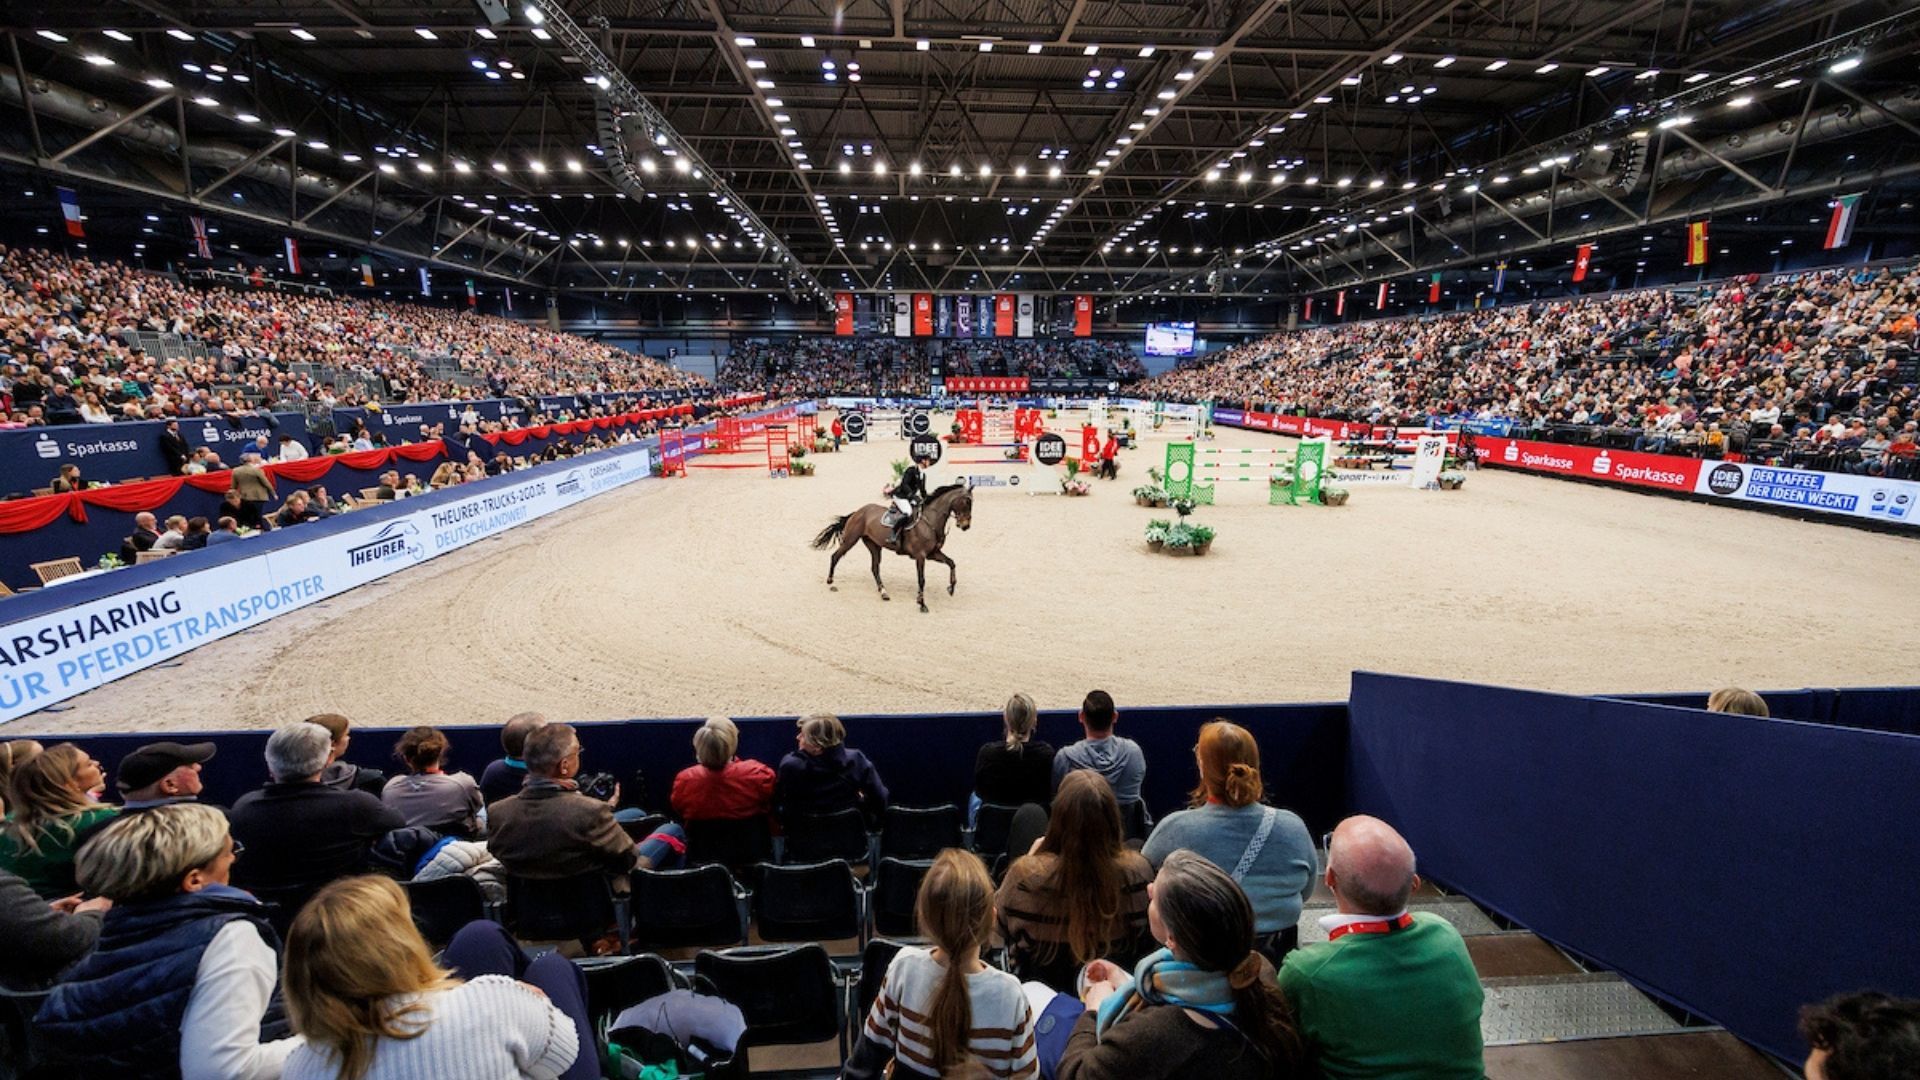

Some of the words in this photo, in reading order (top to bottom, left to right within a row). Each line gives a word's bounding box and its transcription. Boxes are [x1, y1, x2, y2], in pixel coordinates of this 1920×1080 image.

[223, 428, 272, 441] Sparkasse
[67, 438, 138, 458] Sparkasse
[915, 443, 938, 453] IDEE
[1039, 442, 1062, 451] IDEE
[1521, 452, 1574, 470] Sparkasse
[1615, 464, 1685, 485] Sparkasse
[1711, 480, 1738, 489] KAFFEE
[1712, 470, 1741, 482] IDEE
[1753, 470, 1774, 482] DER
[1776, 472, 1820, 489] KAFFEE,
[431, 483, 546, 528] THEURER-TRUCKS-2GO.DE
[1748, 485, 1769, 497] DER
[1771, 487, 1805, 502] IDEEN
[1808, 493, 1855, 509] WECKT!
[435, 506, 528, 548] DEUTSCHLANDWEIT
[347, 534, 405, 567] THEURER
[0, 591, 181, 667] ARSHARING
[57, 575, 325, 687] PFERDETRANSPORTER
